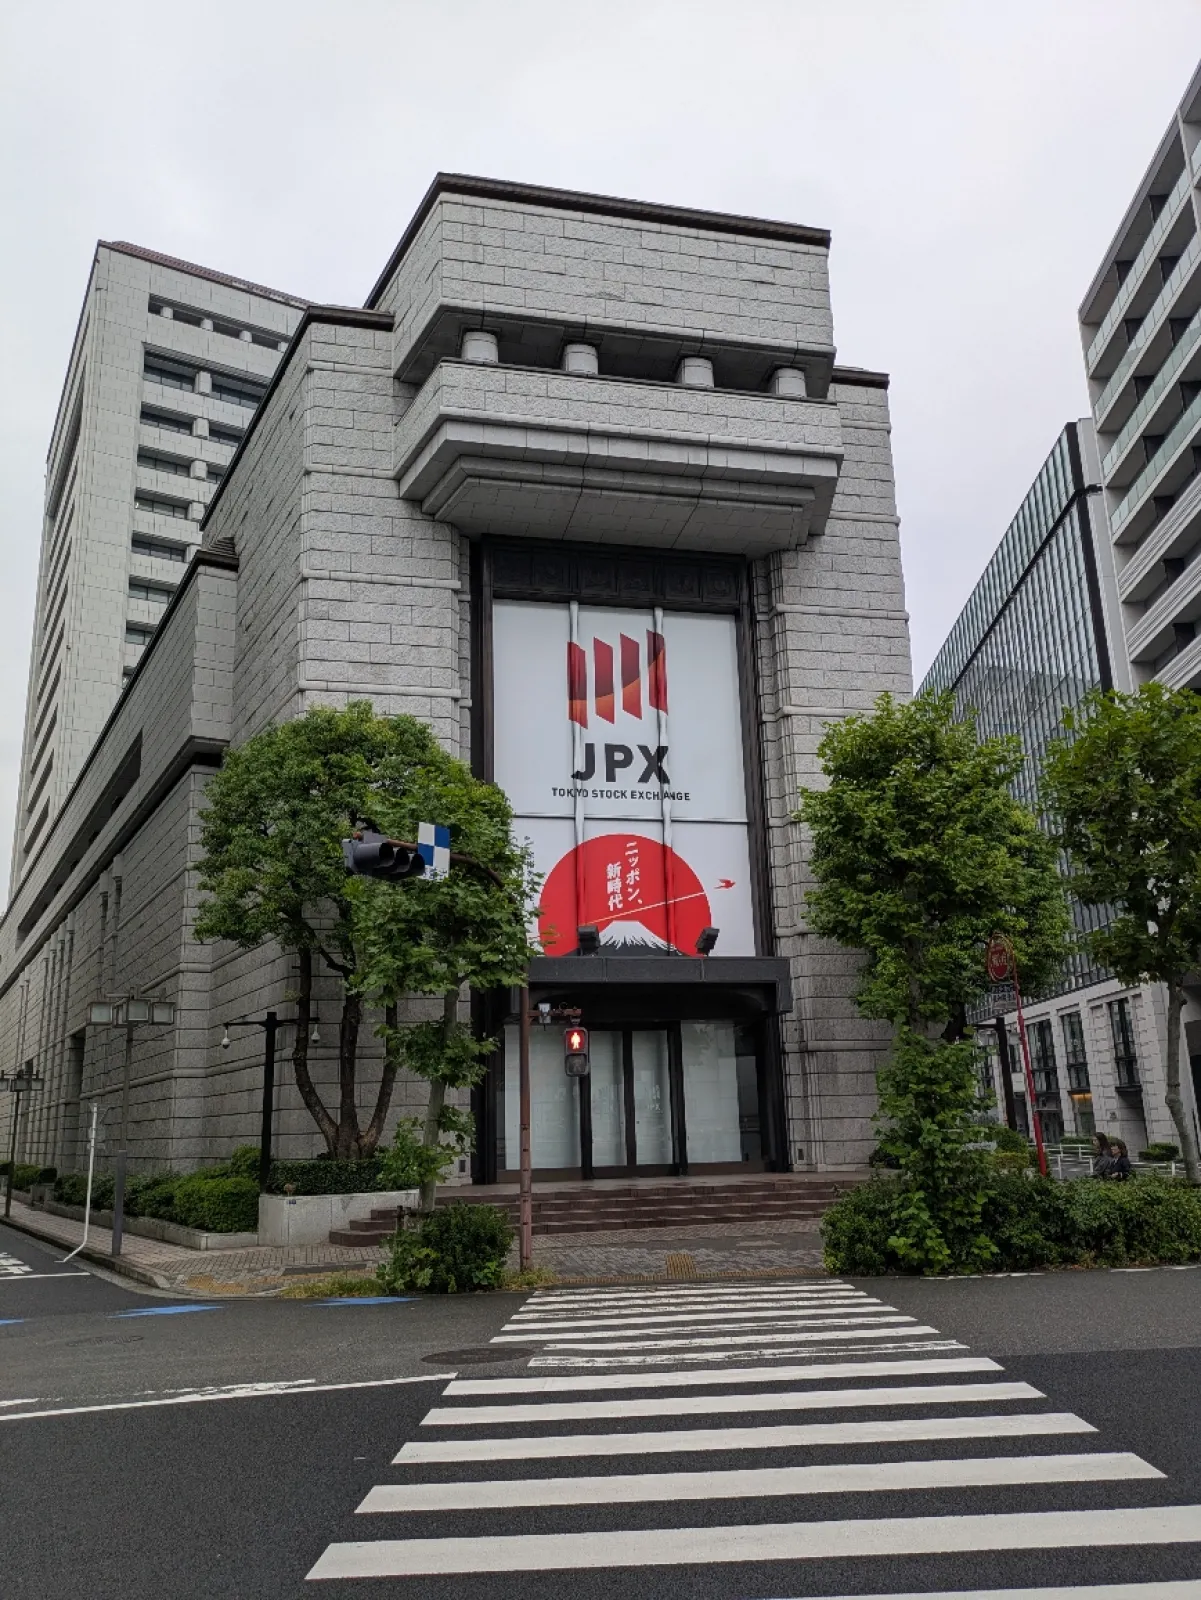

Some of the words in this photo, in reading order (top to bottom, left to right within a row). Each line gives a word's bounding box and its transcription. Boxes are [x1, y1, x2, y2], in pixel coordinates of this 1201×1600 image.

[571, 743, 670, 784] JPX
[551, 787, 589, 798] TOKYO
[591, 789, 628, 799] STOCK
[630, 790, 690, 801] EXCHANGE
[606, 861, 624, 911] 新時代
[625, 841, 643, 904] ニッポン、
